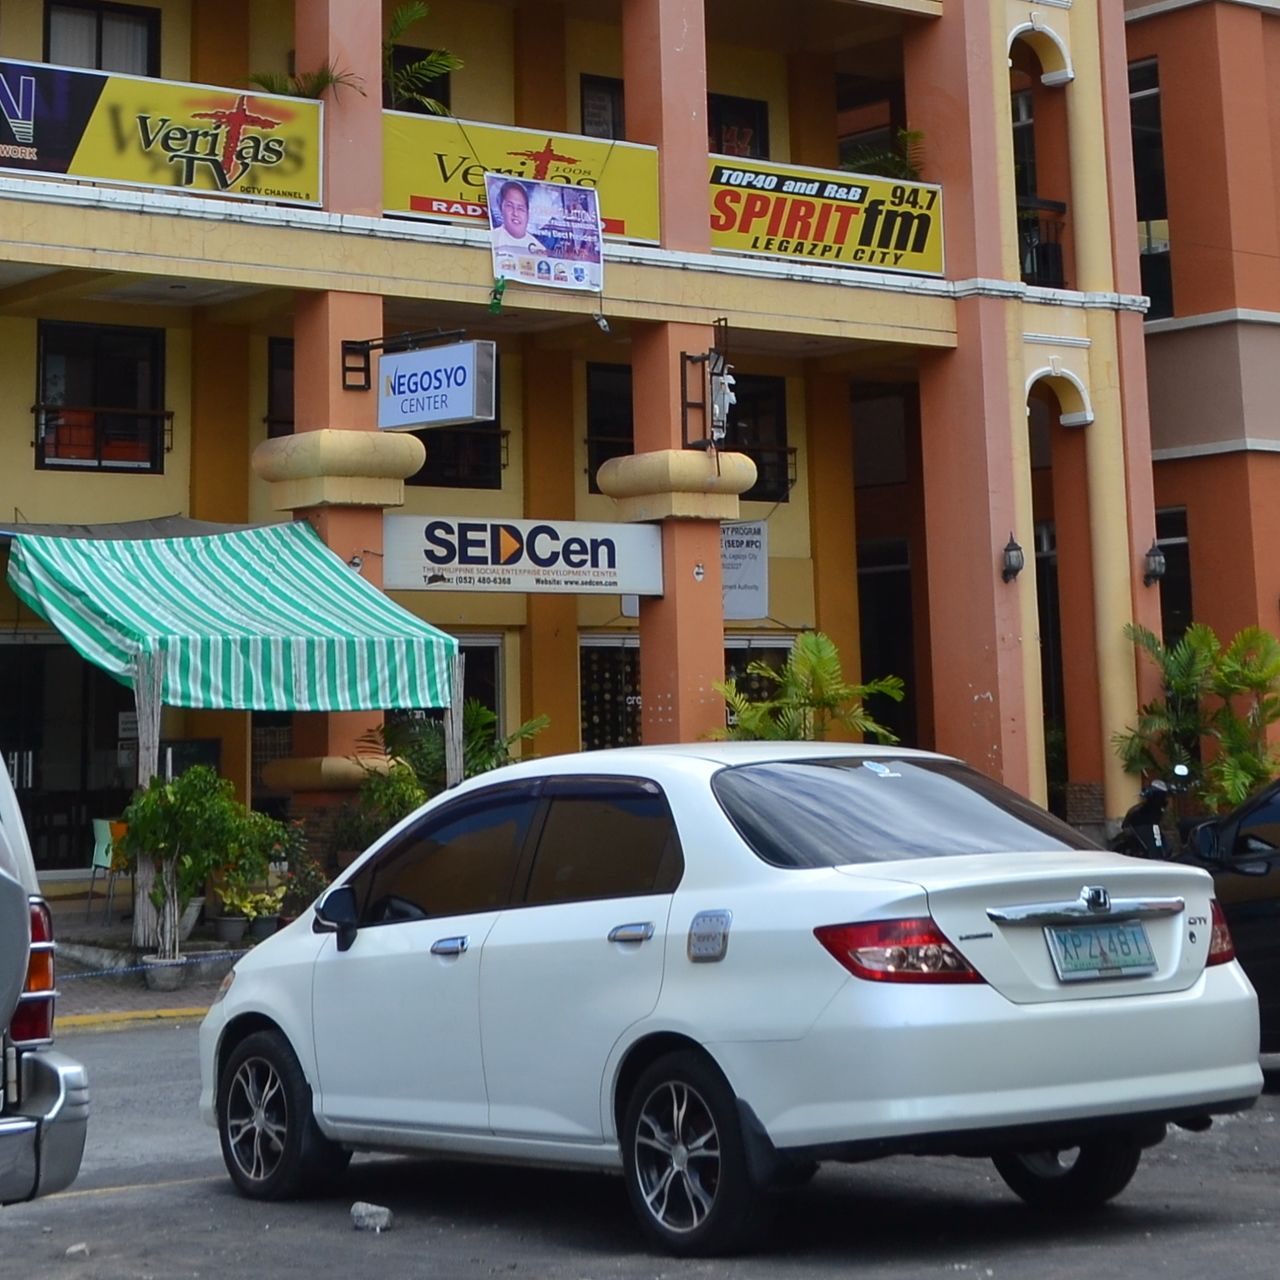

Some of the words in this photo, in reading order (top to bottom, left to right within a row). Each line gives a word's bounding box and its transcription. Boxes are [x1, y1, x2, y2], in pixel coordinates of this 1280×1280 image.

[168, 153, 250, 190] TV
[554, 166, 592, 176] 1008
[720, 169, 778, 190] TOP40
[783, 180, 820, 196] and
[824, 185, 862, 201] R&B
[264, 188, 303, 200] CHANNEL
[890, 186, 938, 211] 94.7
[710, 189, 861, 246] SPIRIT
[858, 199, 932, 253] fm
[751, 236, 844, 259] LEGAZPI
[852, 248, 905, 266] CITY
[385, 364, 467, 397] NEGOSYO
[401, 393, 449, 414] CENTER
[423, 520, 617, 569] SEDCen
